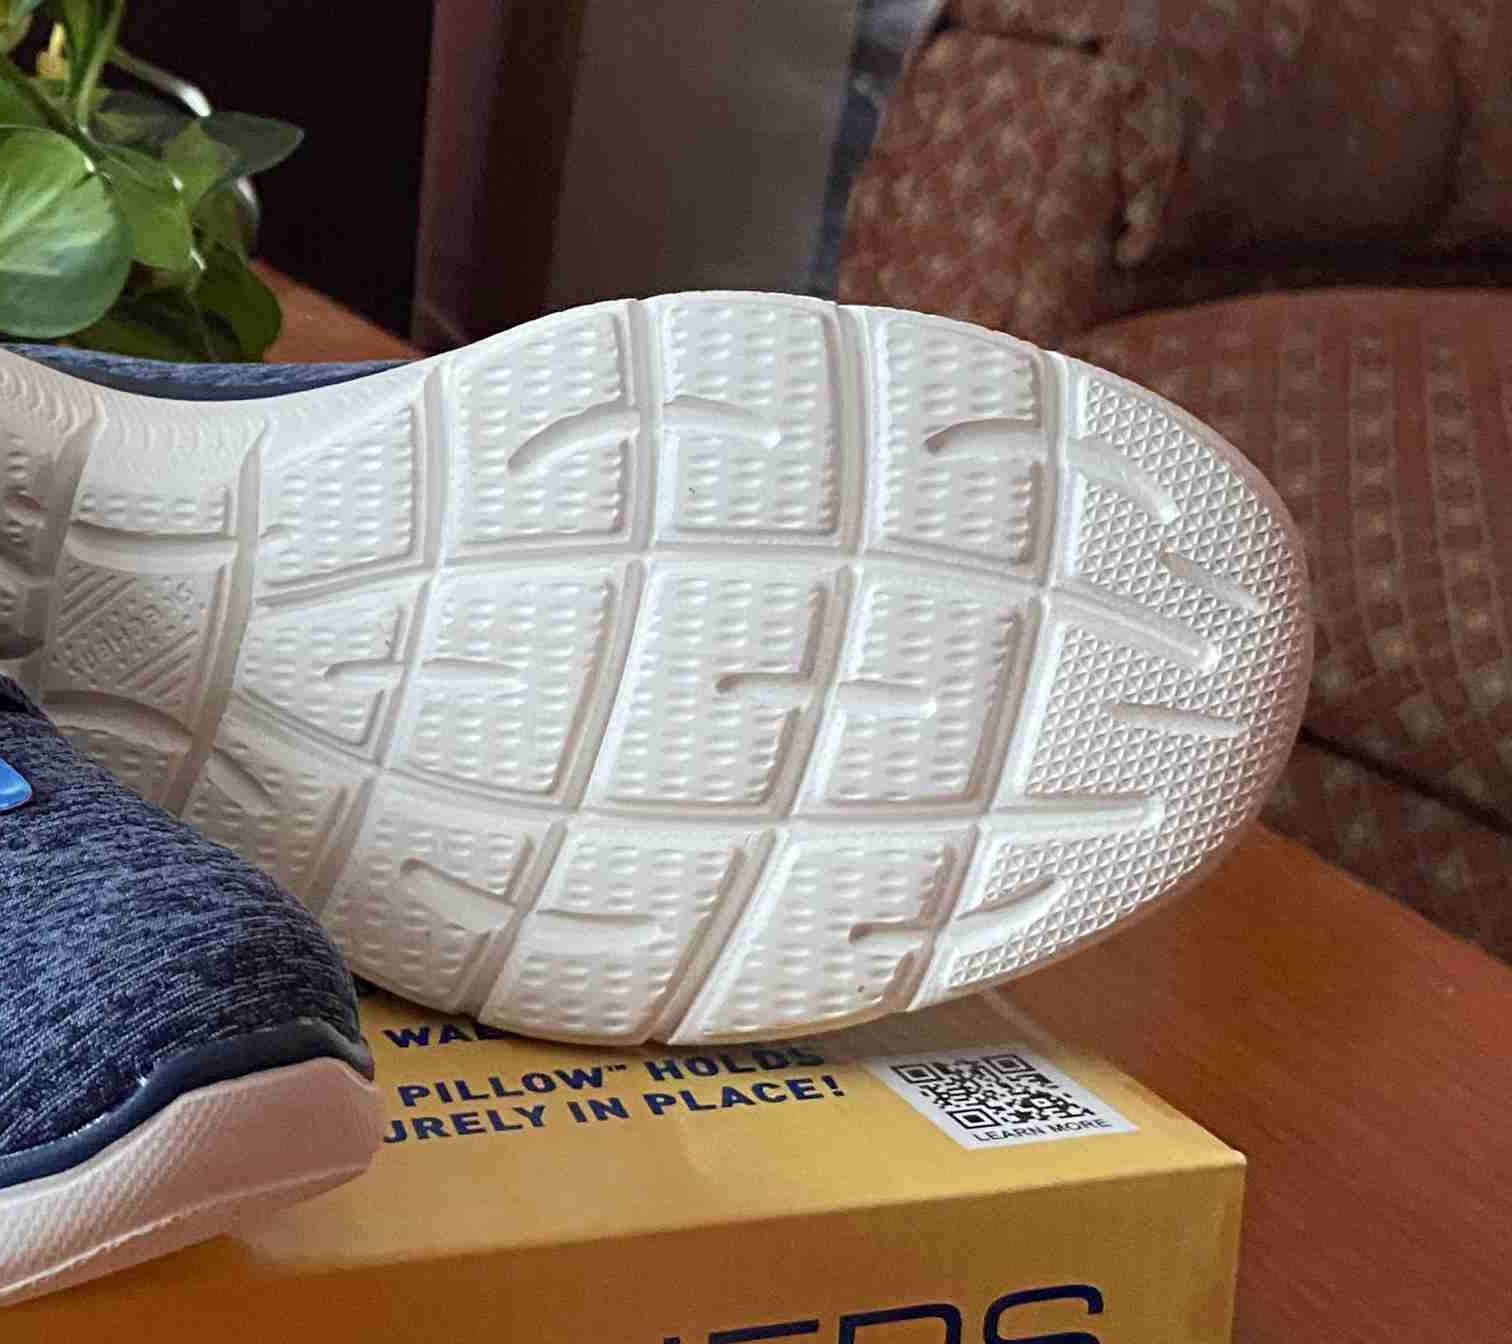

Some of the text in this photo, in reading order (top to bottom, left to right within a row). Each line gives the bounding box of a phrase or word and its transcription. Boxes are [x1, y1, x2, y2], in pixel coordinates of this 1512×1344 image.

[566, 1096, 630, 1122] IN
[642, 1074, 846, 1116] PLACE!
[972, 1117, 1113, 1142] LEARN MORE
